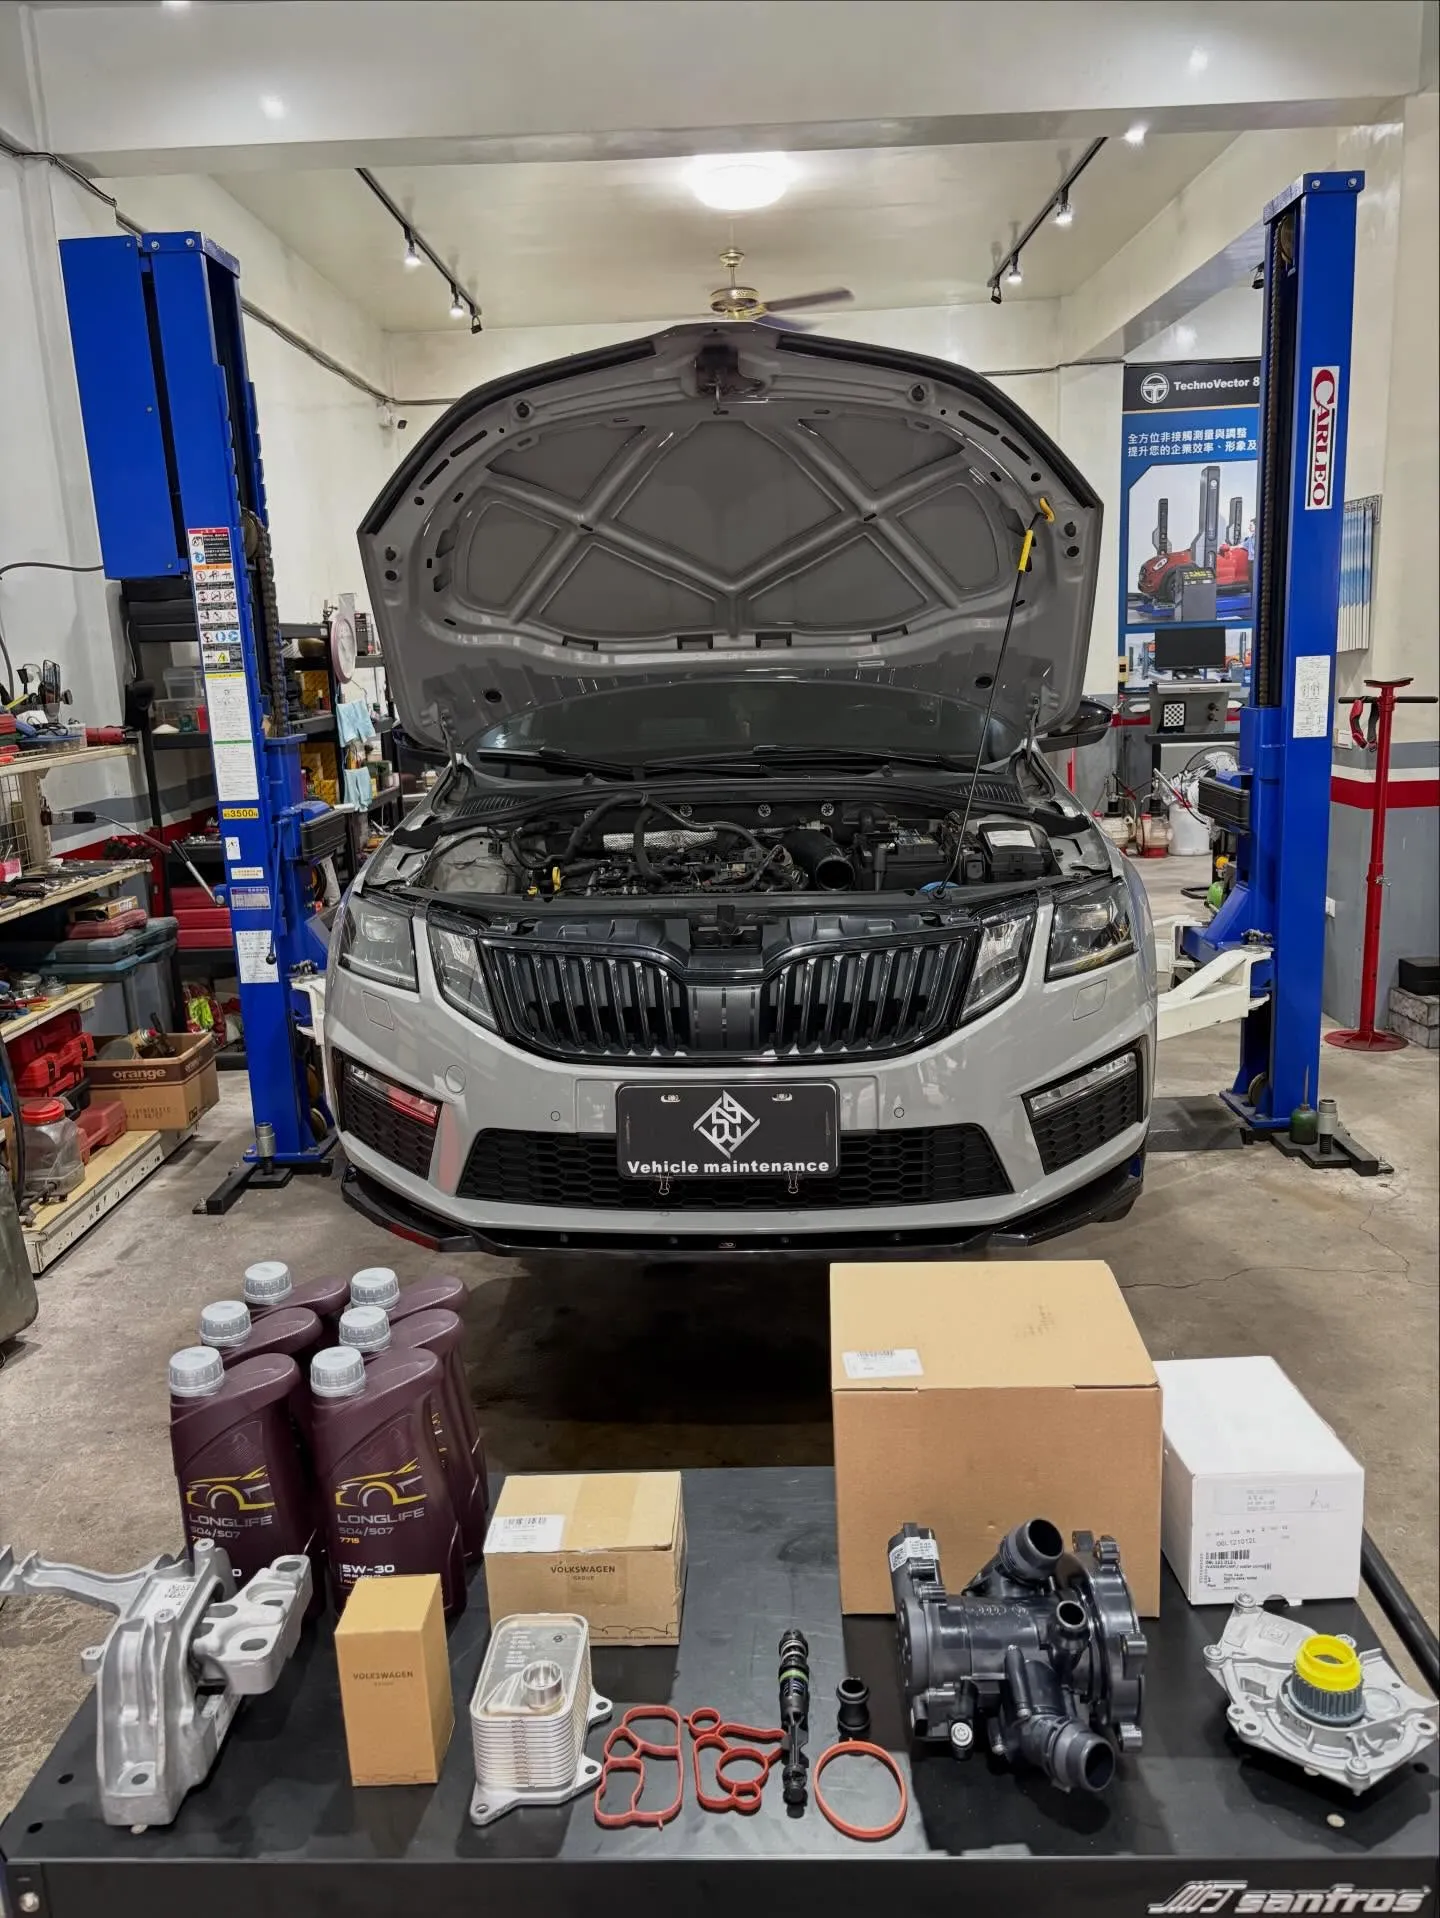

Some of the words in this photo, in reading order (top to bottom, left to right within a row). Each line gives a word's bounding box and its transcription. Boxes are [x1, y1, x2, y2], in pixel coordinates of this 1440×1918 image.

[1173, 378, 1250, 391] TechnoVector
[1127, 427, 1248, 445] 全方位非接觸測量與調整
[1312, 369, 1336, 506] CARLEO
[112, 1069, 167, 1080] orange
[627, 1160, 699, 1174] Vehicle
[703, 1160, 830, 1173] maintenance
[188, 1513, 273, 1528] LONGLIFE
[337, 1507, 425, 1524] LONGLIFE
[190, 1525, 241, 1539] 504/507
[338, 1526, 395, 1537] 504/507
[342, 1564, 396, 1574] 5W-30
[551, 1565, 616, 1574] VOLKSWAGEN
[353, 1671, 414, 1680] VOLKSWAGEN
[1235, 1883, 1427, 1914] sanfros
